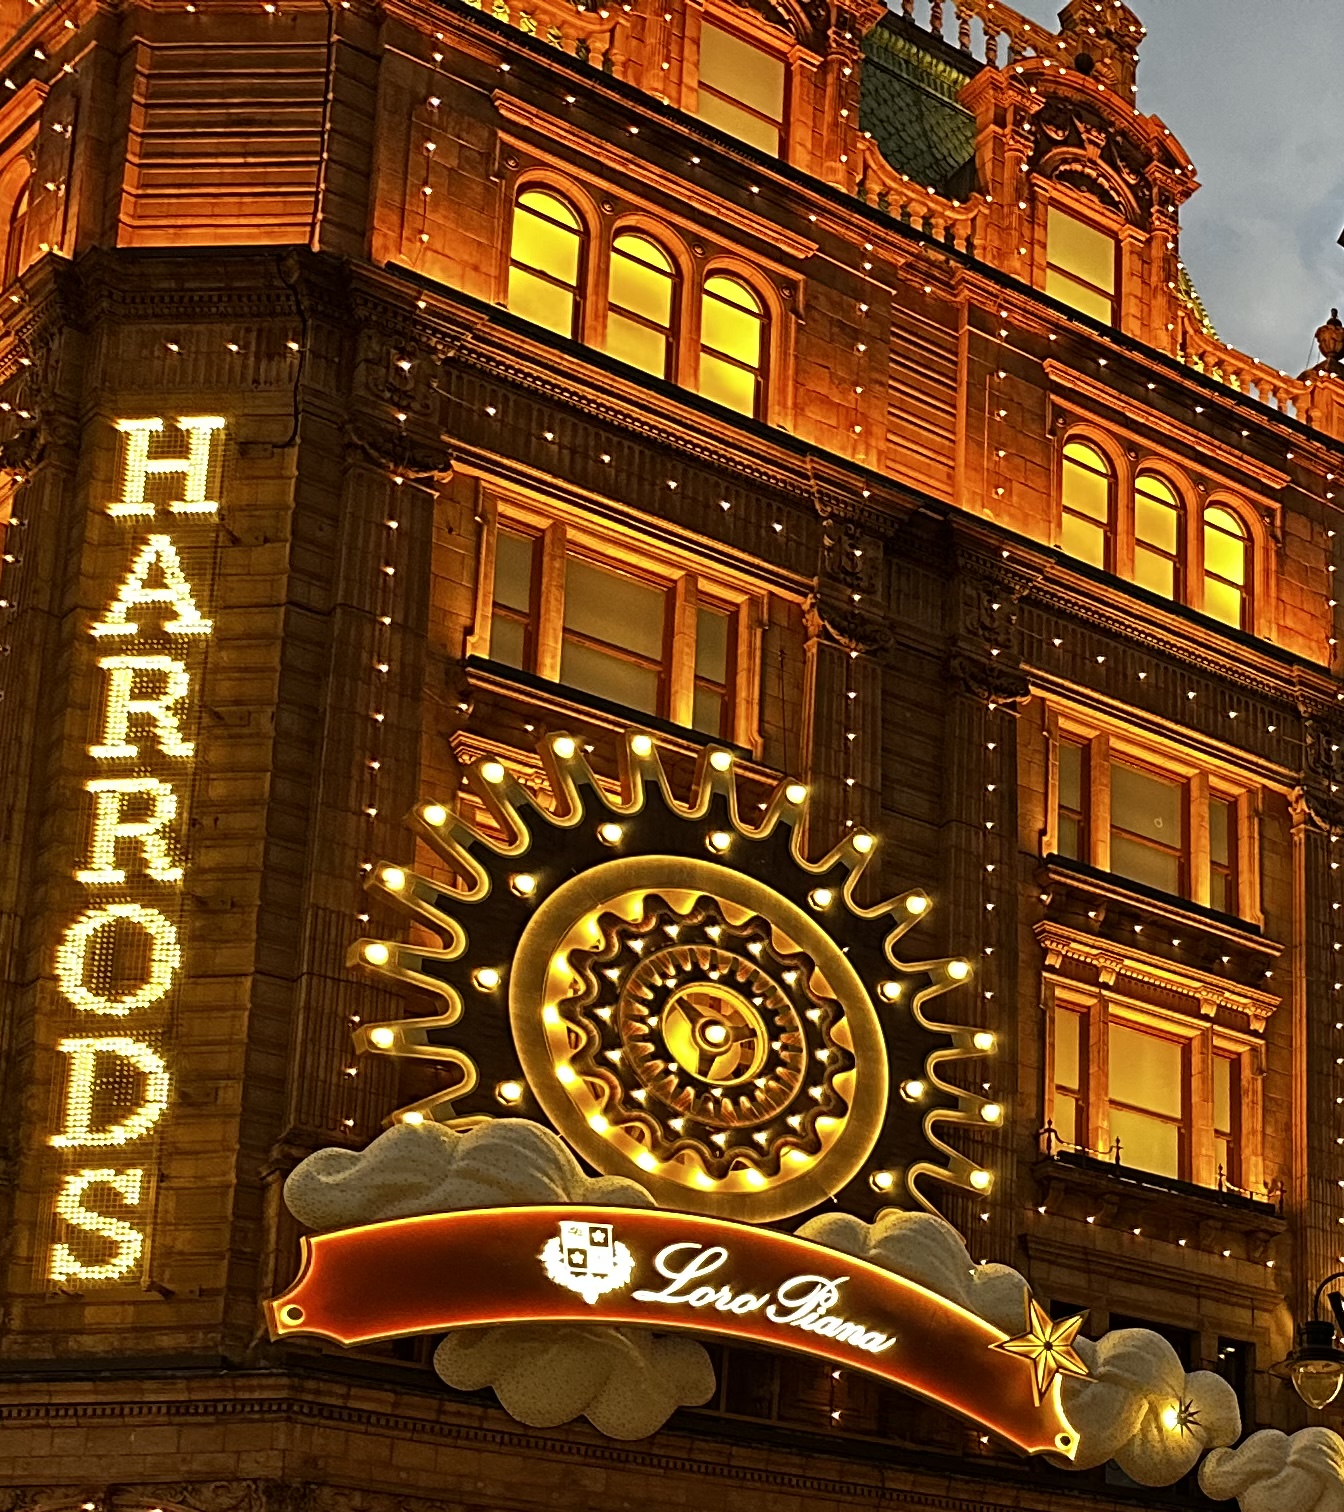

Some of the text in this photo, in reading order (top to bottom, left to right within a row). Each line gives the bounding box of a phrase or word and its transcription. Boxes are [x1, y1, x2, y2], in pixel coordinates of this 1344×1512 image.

[51, 414, 229, 1283] HARRODS
[632, 1242, 897, 1353] Loro Piana
